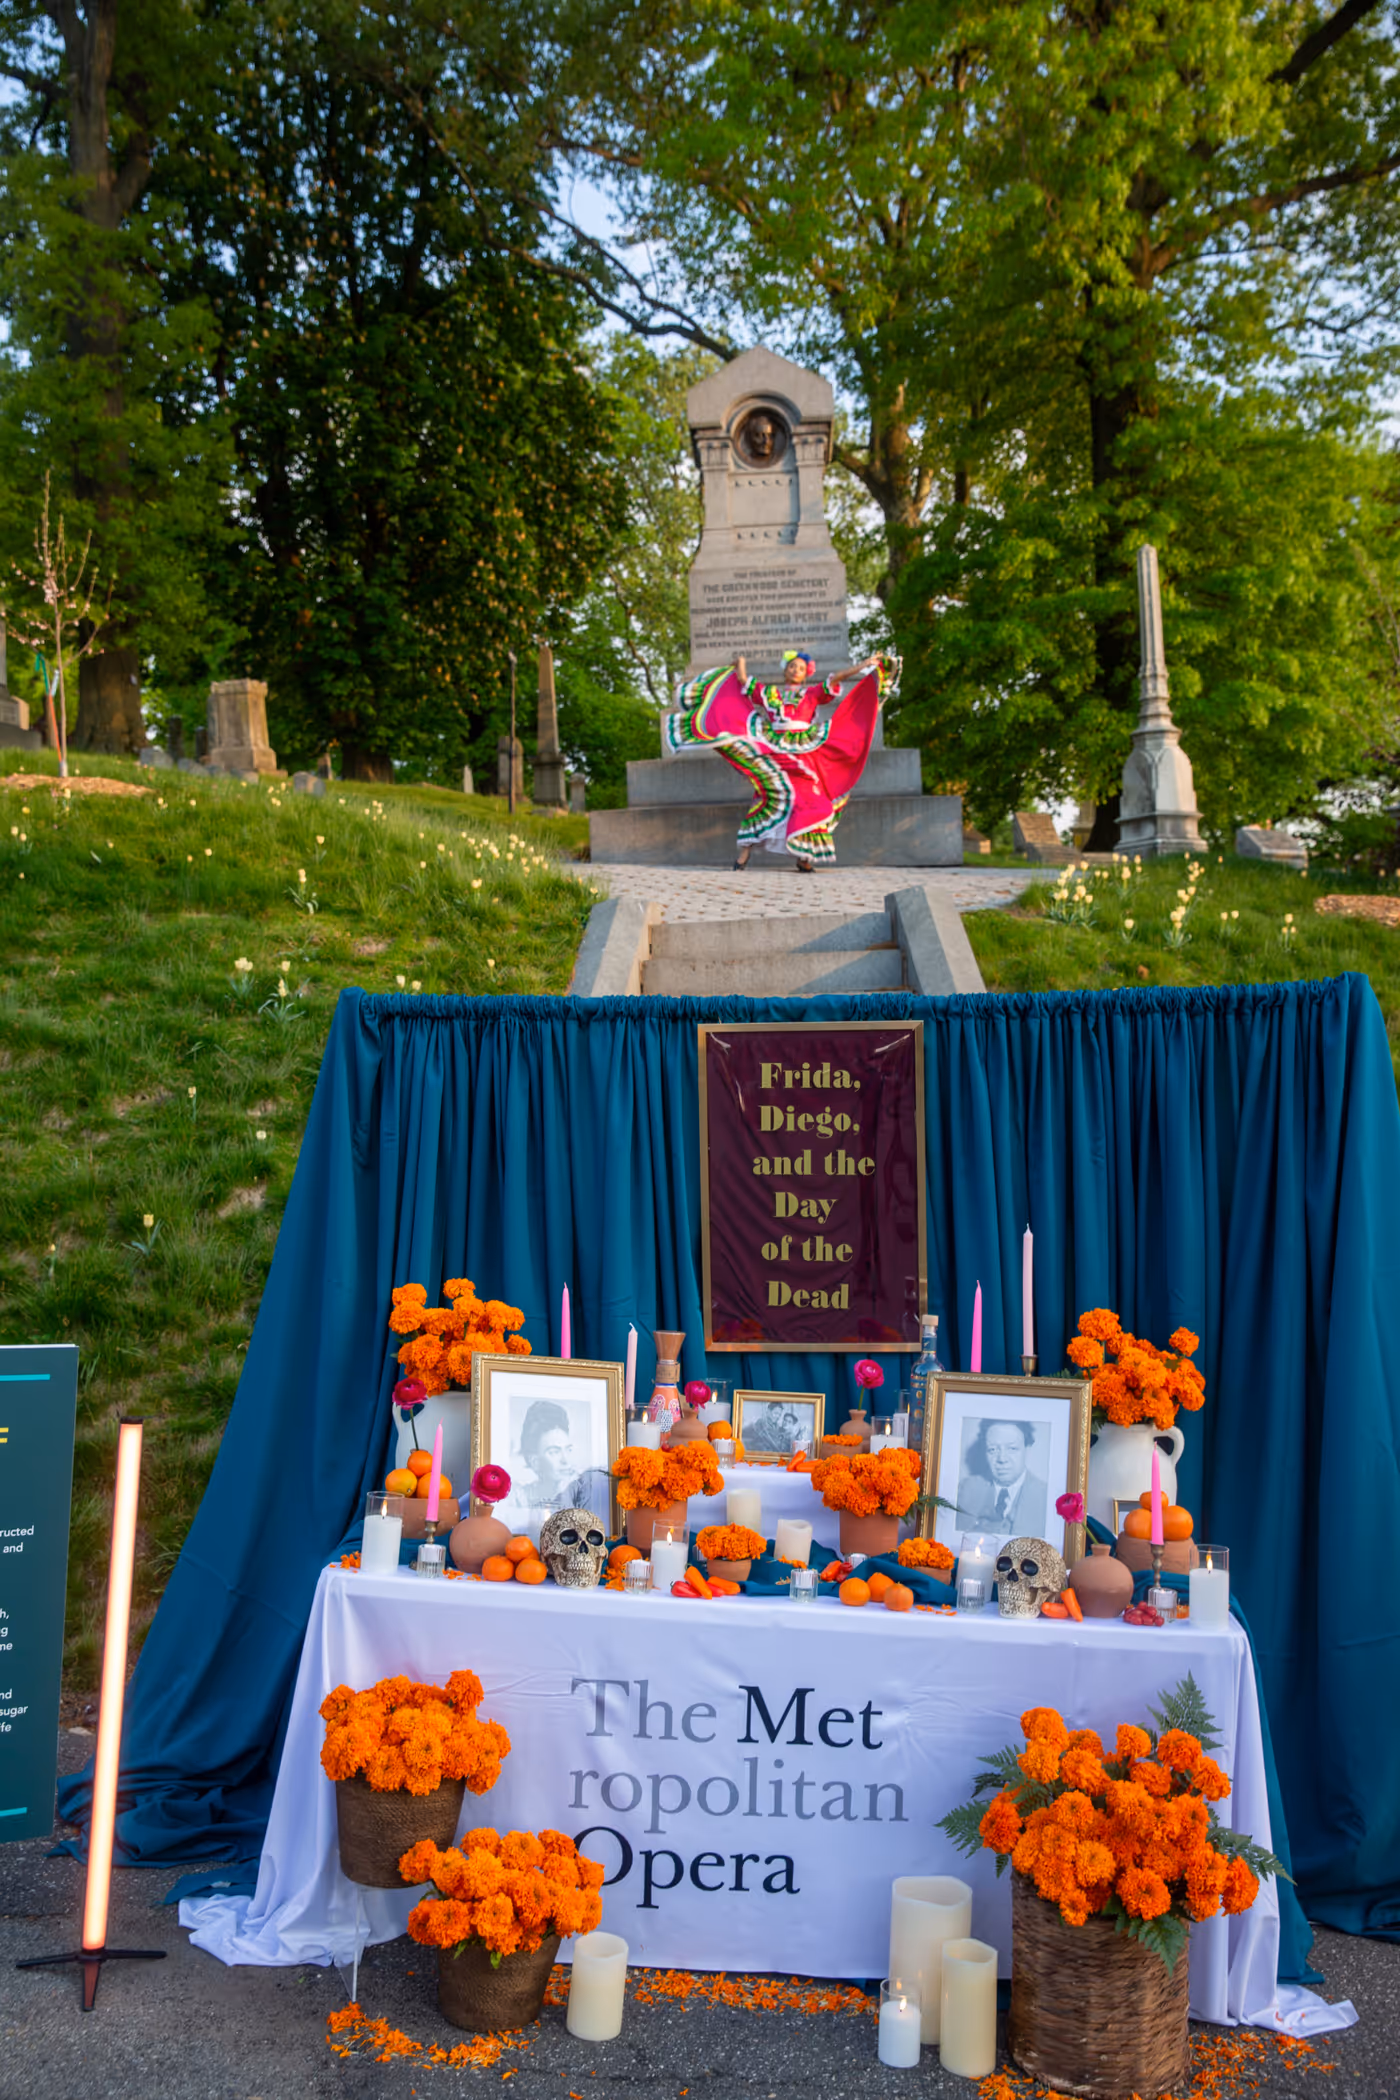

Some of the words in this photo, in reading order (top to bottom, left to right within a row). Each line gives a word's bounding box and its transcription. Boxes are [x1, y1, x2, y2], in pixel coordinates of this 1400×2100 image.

[703, 584, 718, 594] THE
[780, 577, 829, 589] CEMETERY
[706, 616, 747, 628] JOSEPH
[751, 614, 790, 625] ALFRED
[794, 612, 828, 623] PERRY
[759, 1062, 861, 1092] Frida,
[757, 1105, 860, 1138] Diego,
[752, 1149, 812, 1176] and
[824, 1149, 876, 1176] the
[773, 1191, 838, 1224] Day
[761, 1235, 793, 1261] of
[802, 1235, 853, 1262] the
[767, 1280, 849, 1309] Dead
[3, 1542, 24, 1553] and
[0, 1706, 28, 1718] sugar
[571, 1678, 717, 1743] The
[737, 1685, 884, 1750] Met
[568, 1756, 910, 1834] ropolitan
[573, 1826, 801, 1909] Opera
